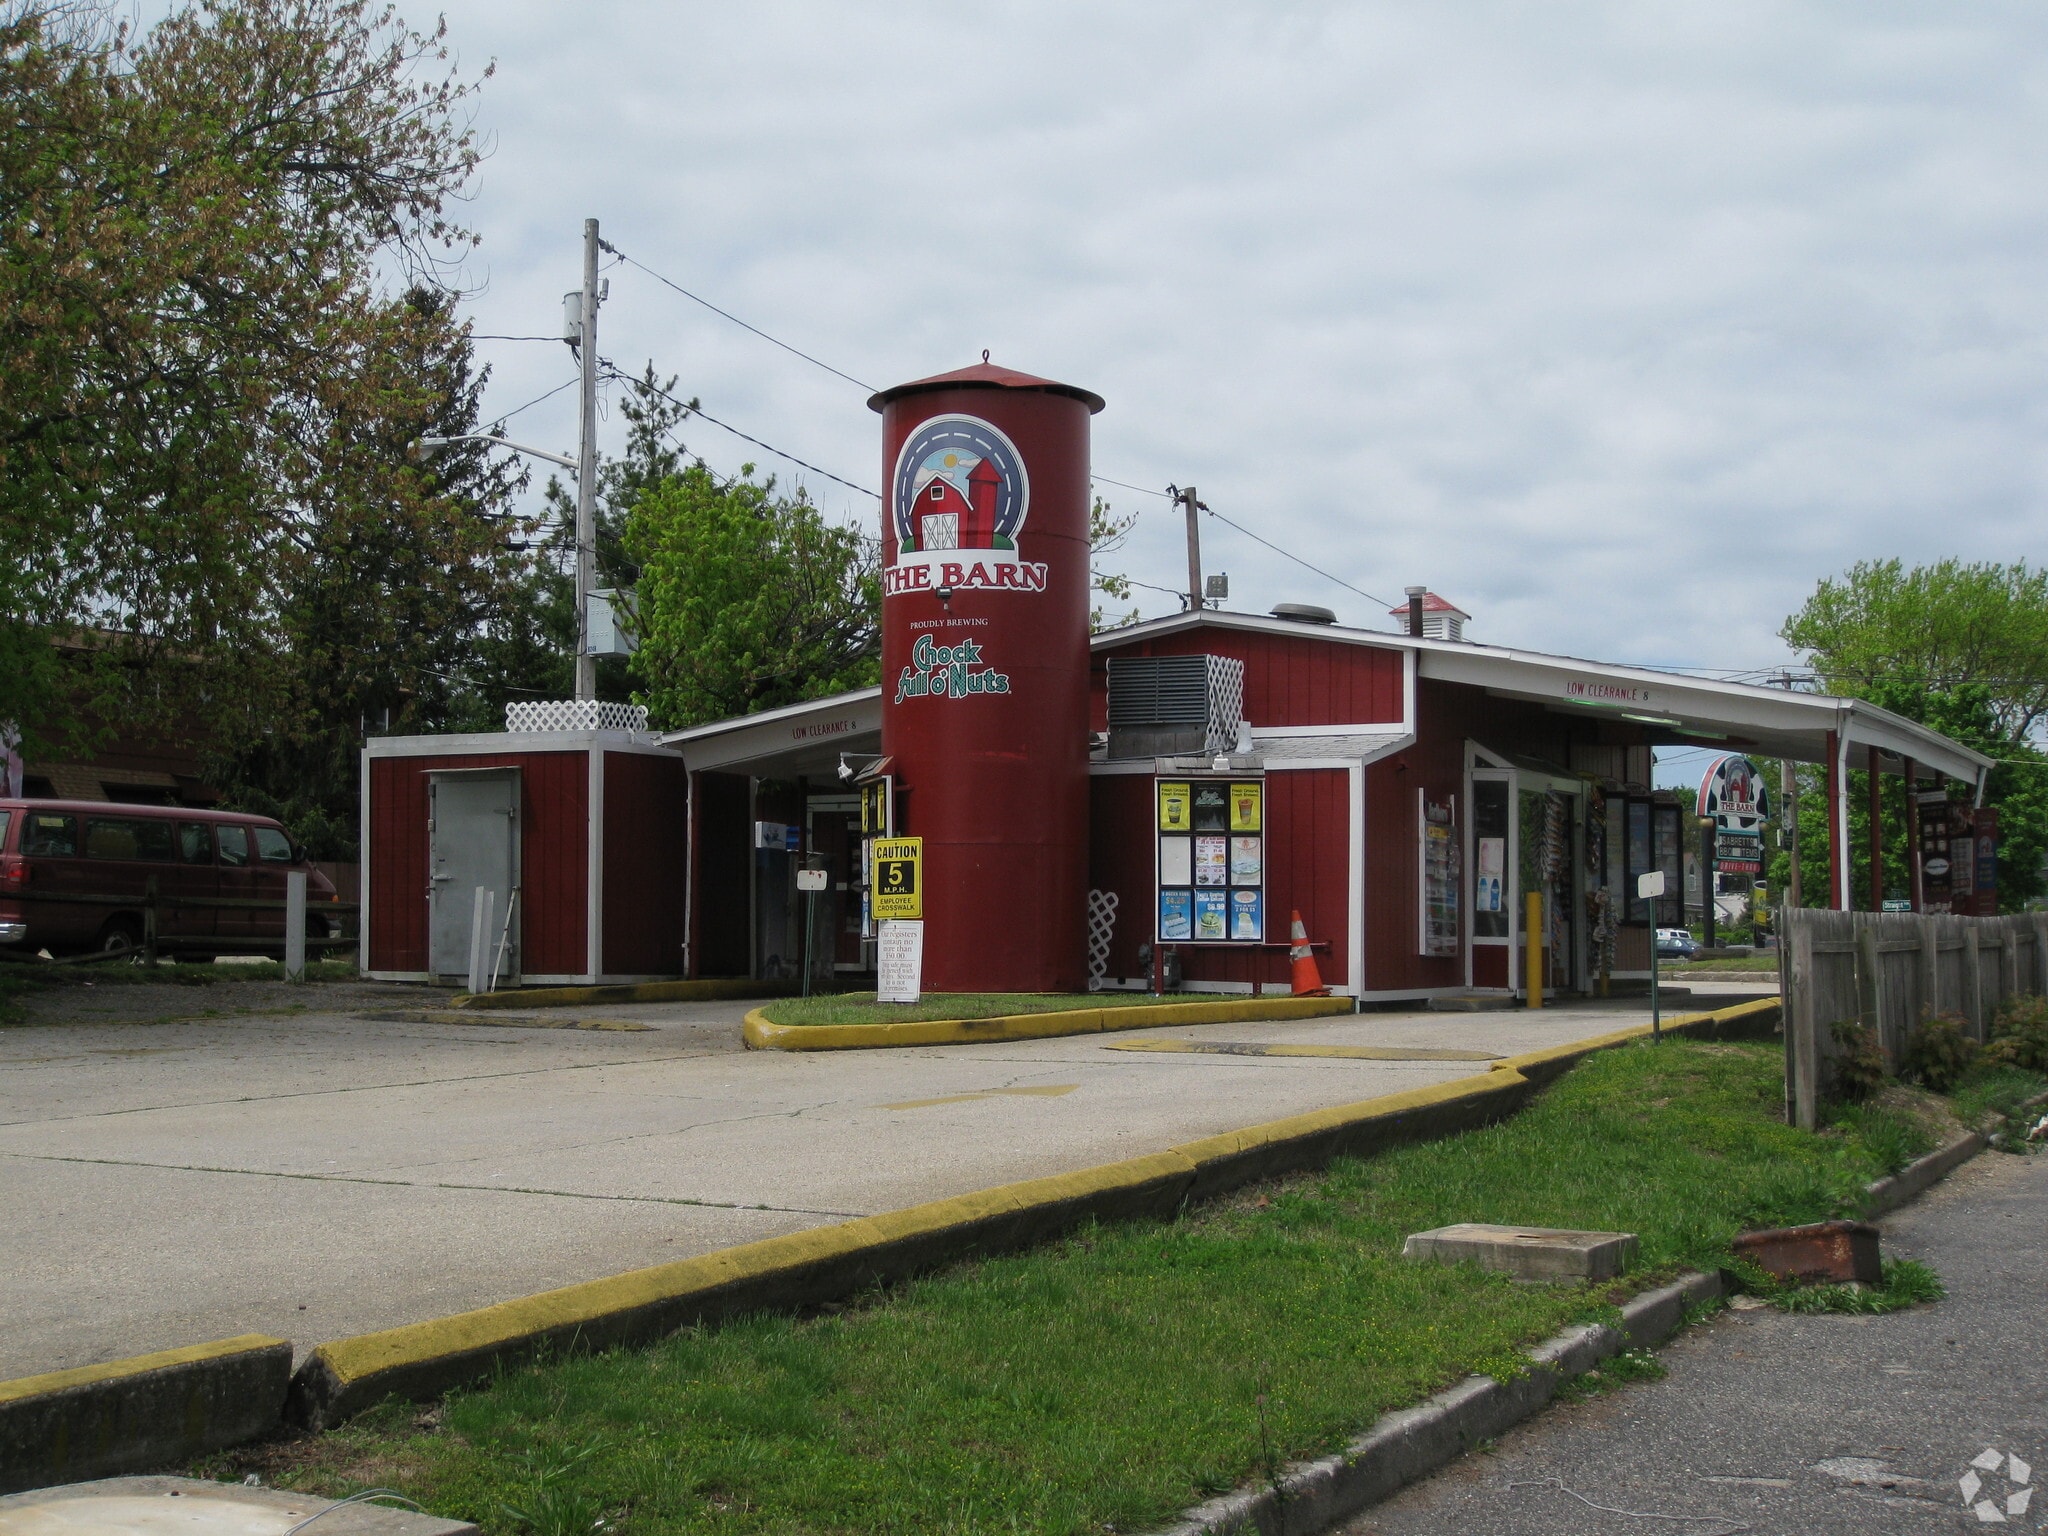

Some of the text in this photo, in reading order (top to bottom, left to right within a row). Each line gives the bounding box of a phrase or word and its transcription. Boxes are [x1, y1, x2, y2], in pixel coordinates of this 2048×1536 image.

[885, 562, 1048, 595] THE BARN
[910, 618, 988, 630] PROUDLY BREWING
[913, 634, 982, 671] Chock
[895, 664, 928, 704] full
[948, 663, 1009, 699] Nuts
[1567, 682, 1585, 695] LOW
[1588, 684, 1637, 701] CLEARANCE
[792, 727, 807, 740] LOW
[809, 719, 850, 738] CLEARANCE
[1736, 803, 1755, 812] BARN
[876, 845, 918, 859] CAUTION
[888, 862, 903, 885] 5
[877, 904, 916, 912] CROSSWALK
[880, 897, 912, 905] EMPLOYEE
